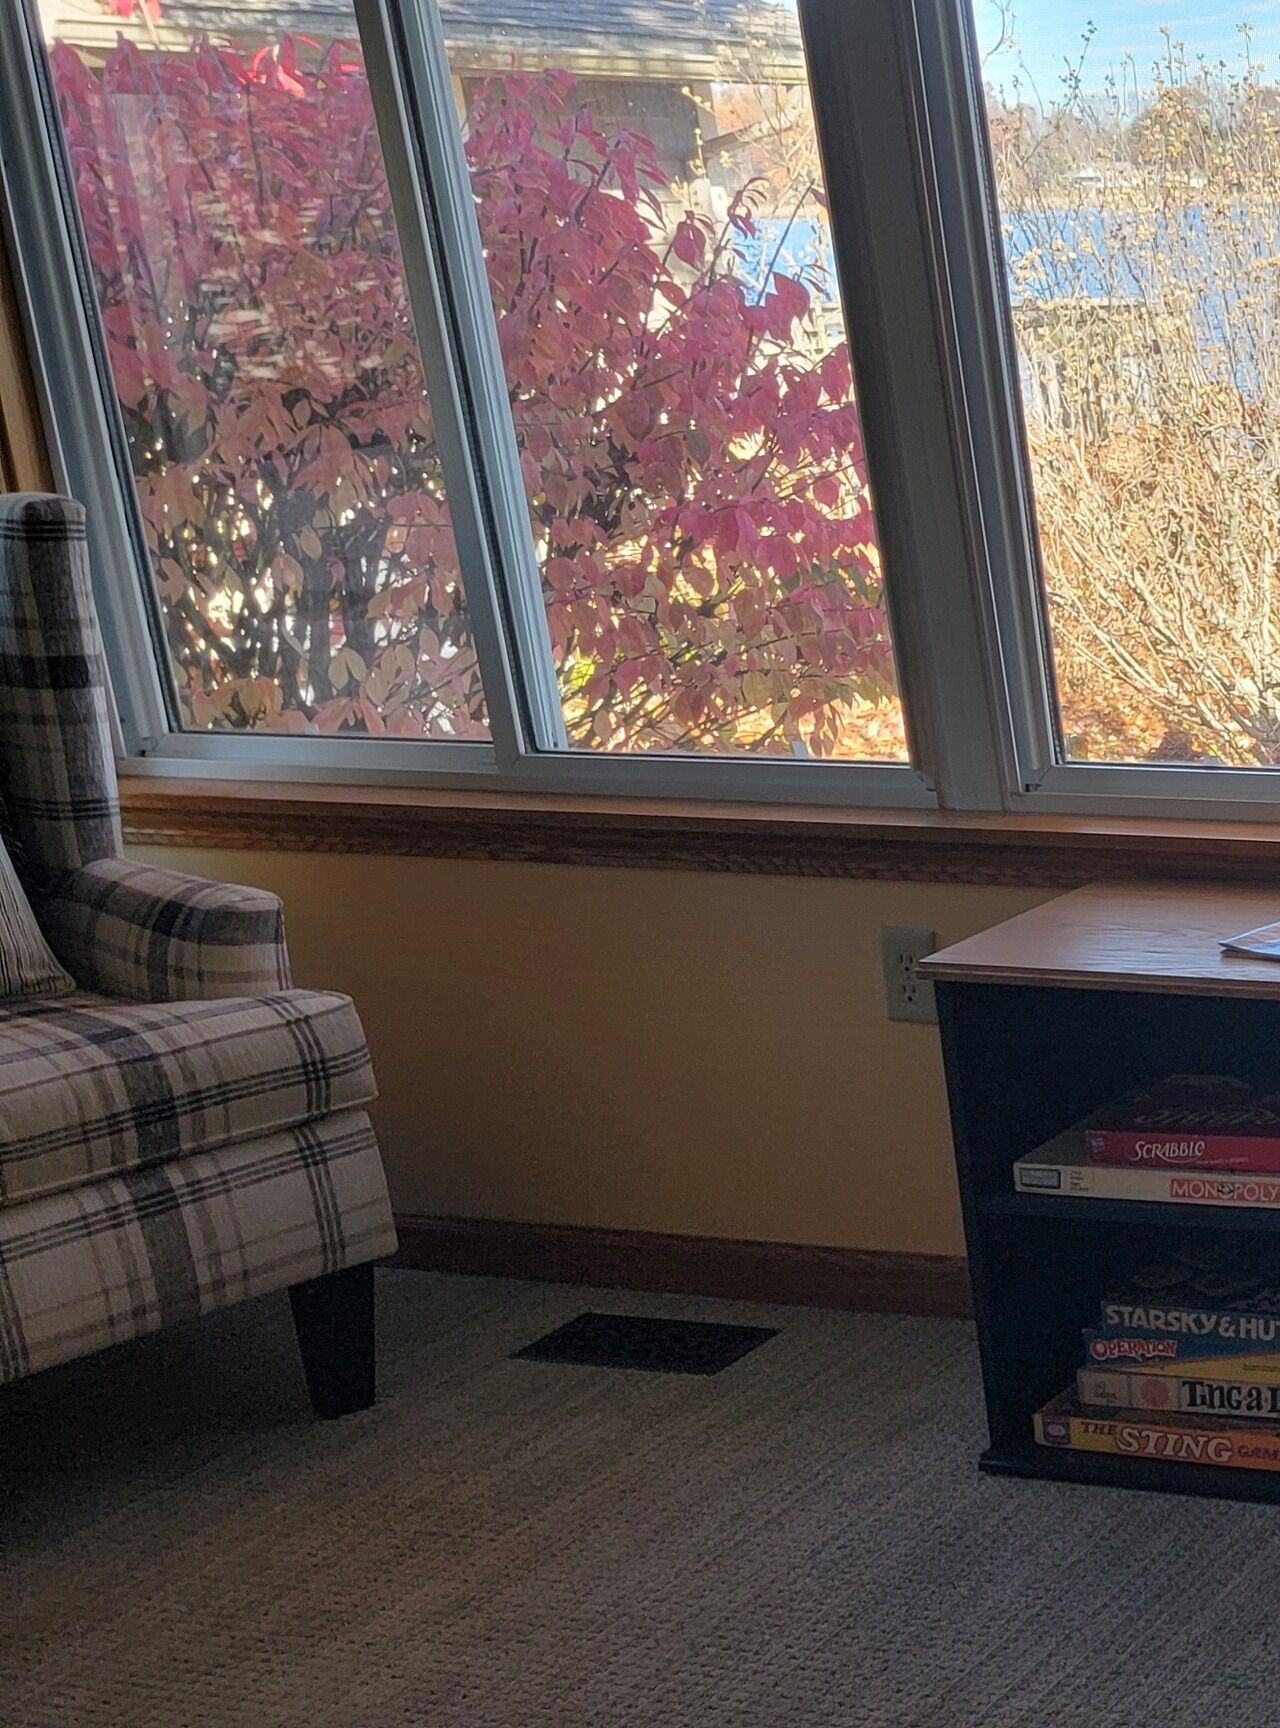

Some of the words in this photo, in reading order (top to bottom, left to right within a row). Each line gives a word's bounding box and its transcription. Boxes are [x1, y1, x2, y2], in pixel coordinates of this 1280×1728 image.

[1172, 1179, 1280, 1202] MONOPOLY
[1105, 1304, 1218, 1336] STARSKY
[1218, 1316, 1236, 1338] &
[1089, 1338, 1178, 1361] OPERATION
[1081, 1421, 1118, 1437] THE
[1115, 1425, 1233, 1464] STING
